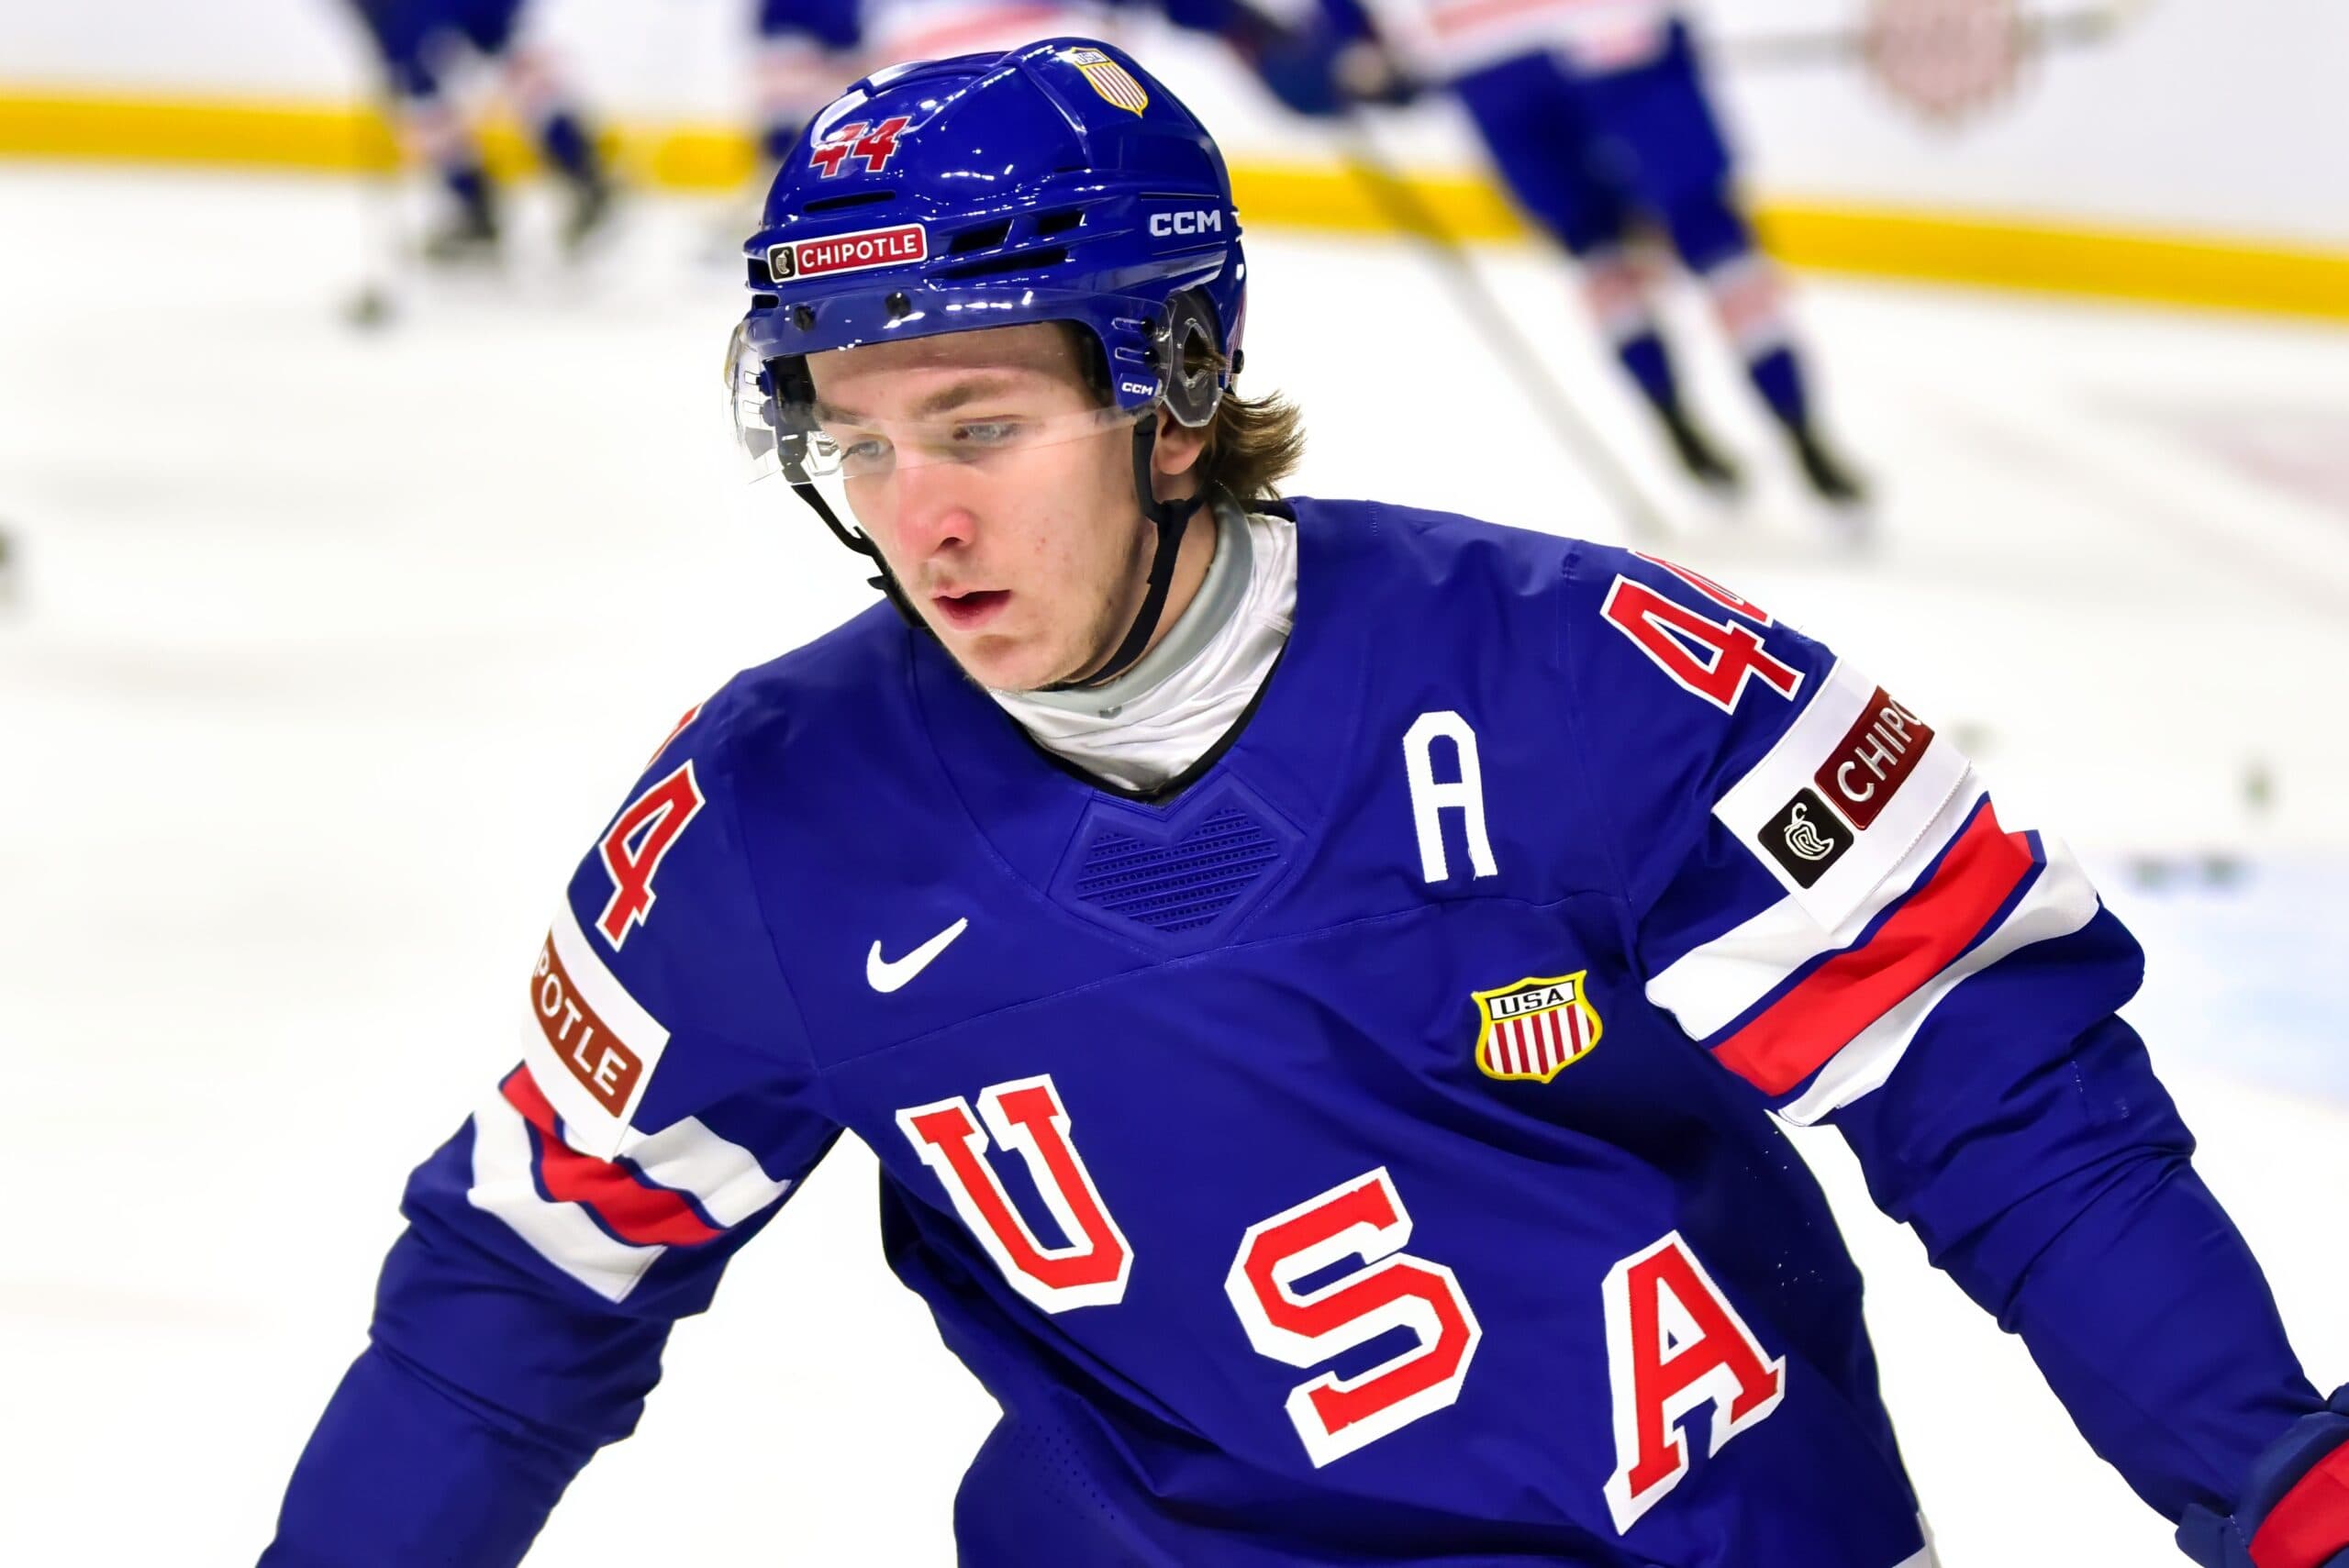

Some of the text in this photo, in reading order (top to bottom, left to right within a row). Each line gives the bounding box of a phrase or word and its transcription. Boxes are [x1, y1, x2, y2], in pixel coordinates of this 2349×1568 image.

[808, 116, 912, 179] 44
[1150, 209, 1221, 237] CCM
[801, 234, 918, 268] CHIPOTLE
[1121, 382, 1153, 396] CCM
[1402, 710, 1497, 884] A
[595, 702, 706, 952] 4
[1500, 988, 1564, 1016] USA
[896, 1073, 1786, 1536] USA
